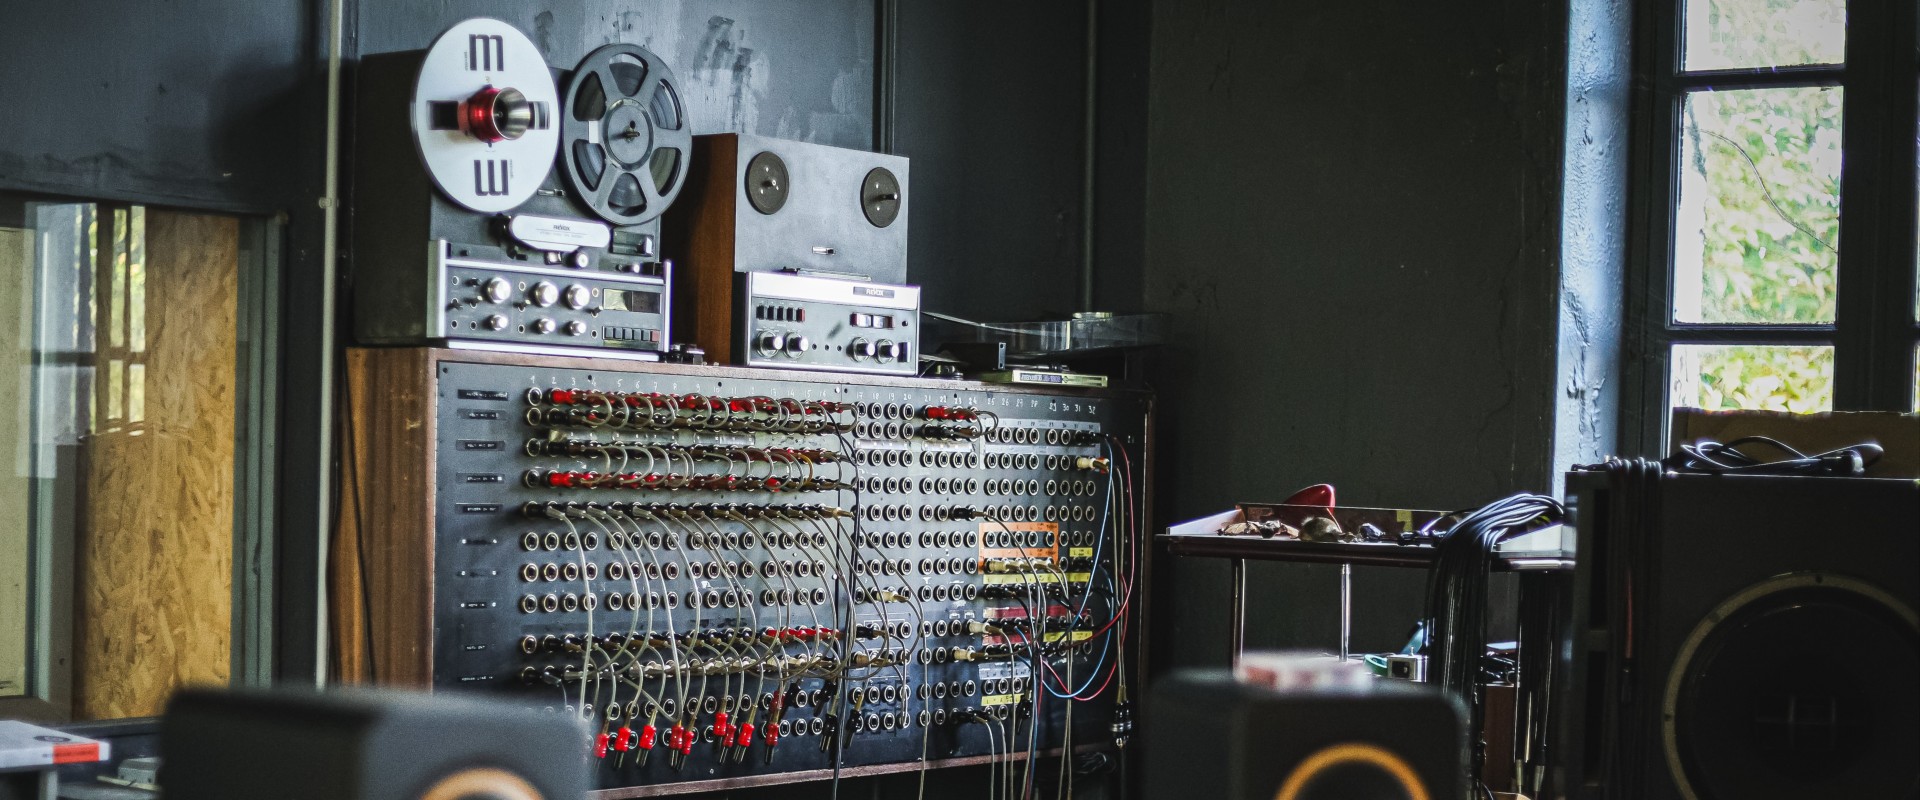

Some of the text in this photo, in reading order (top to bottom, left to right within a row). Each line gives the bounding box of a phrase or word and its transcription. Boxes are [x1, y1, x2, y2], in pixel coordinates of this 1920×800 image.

[787, 389, 795, 398] 14
[804, 389, 812, 399] 15
[856, 391, 864, 400] 17
[872, 392, 880, 401] 18
[888, 392, 895, 401] 19
[903, 393, 912, 401] 20
[924, 395, 931, 403] 21
[1062, 403, 1070, 412] 30
[1074, 403, 1081, 412] 31
